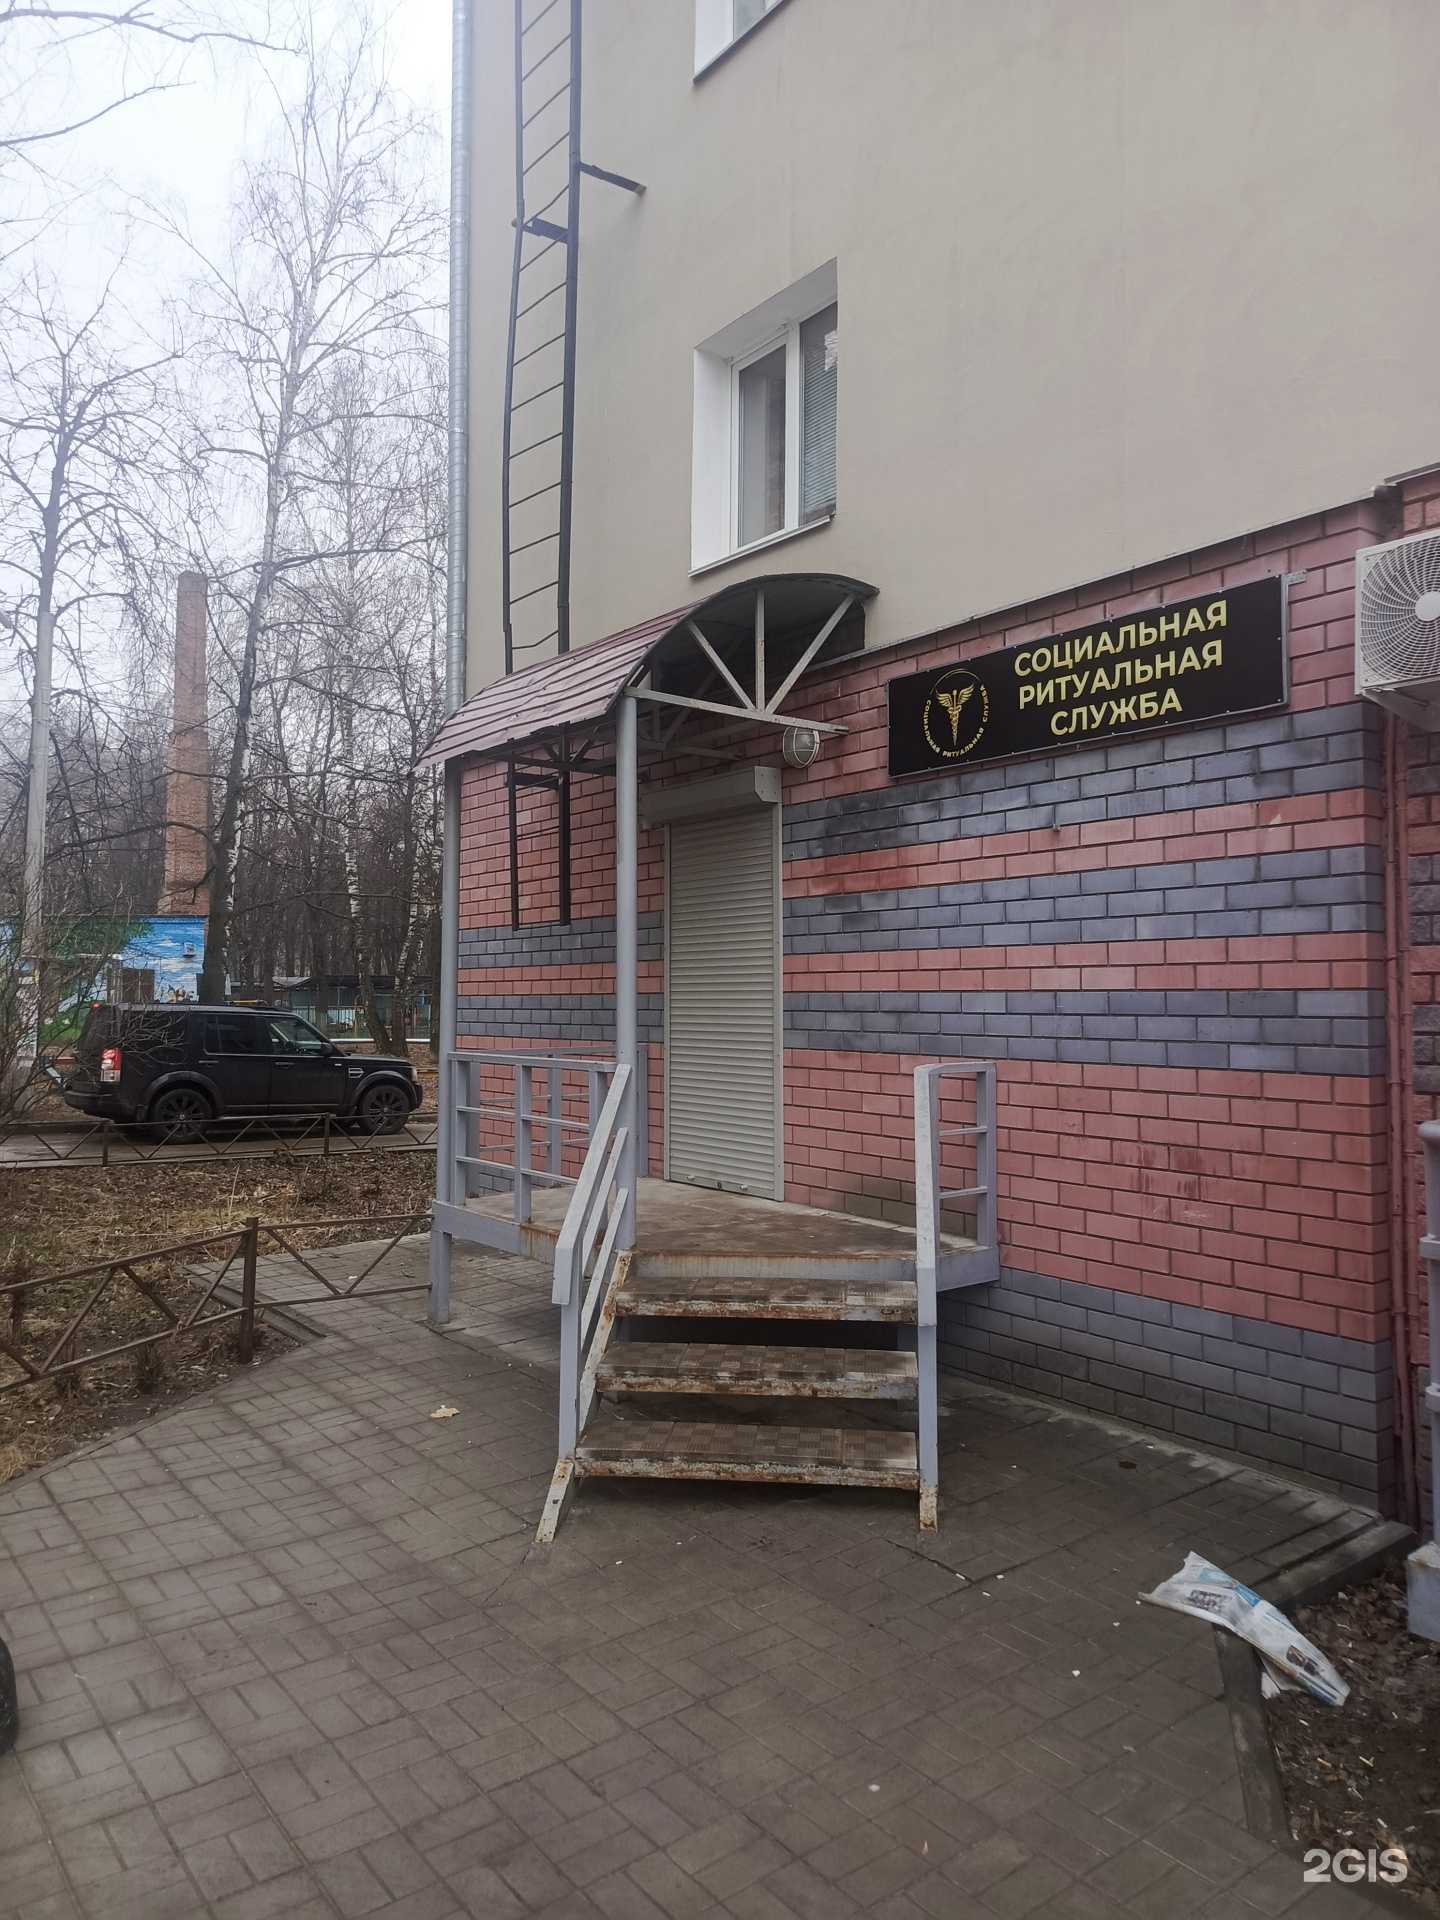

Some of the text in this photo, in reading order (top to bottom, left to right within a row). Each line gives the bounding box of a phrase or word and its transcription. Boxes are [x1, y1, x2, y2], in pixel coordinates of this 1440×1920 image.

[1013, 599, 1227, 677] СОЦИАЛЬНАЯ
[1018, 639, 1223, 710] РИТУАЛЬНАЯ
[923, 699, 941, 753] СОЦИАЛЬНАЯ
[942, 727, 984, 757] РИТУАЛЬНАЯ
[1050, 688, 1183, 736] СЛУЖБА
